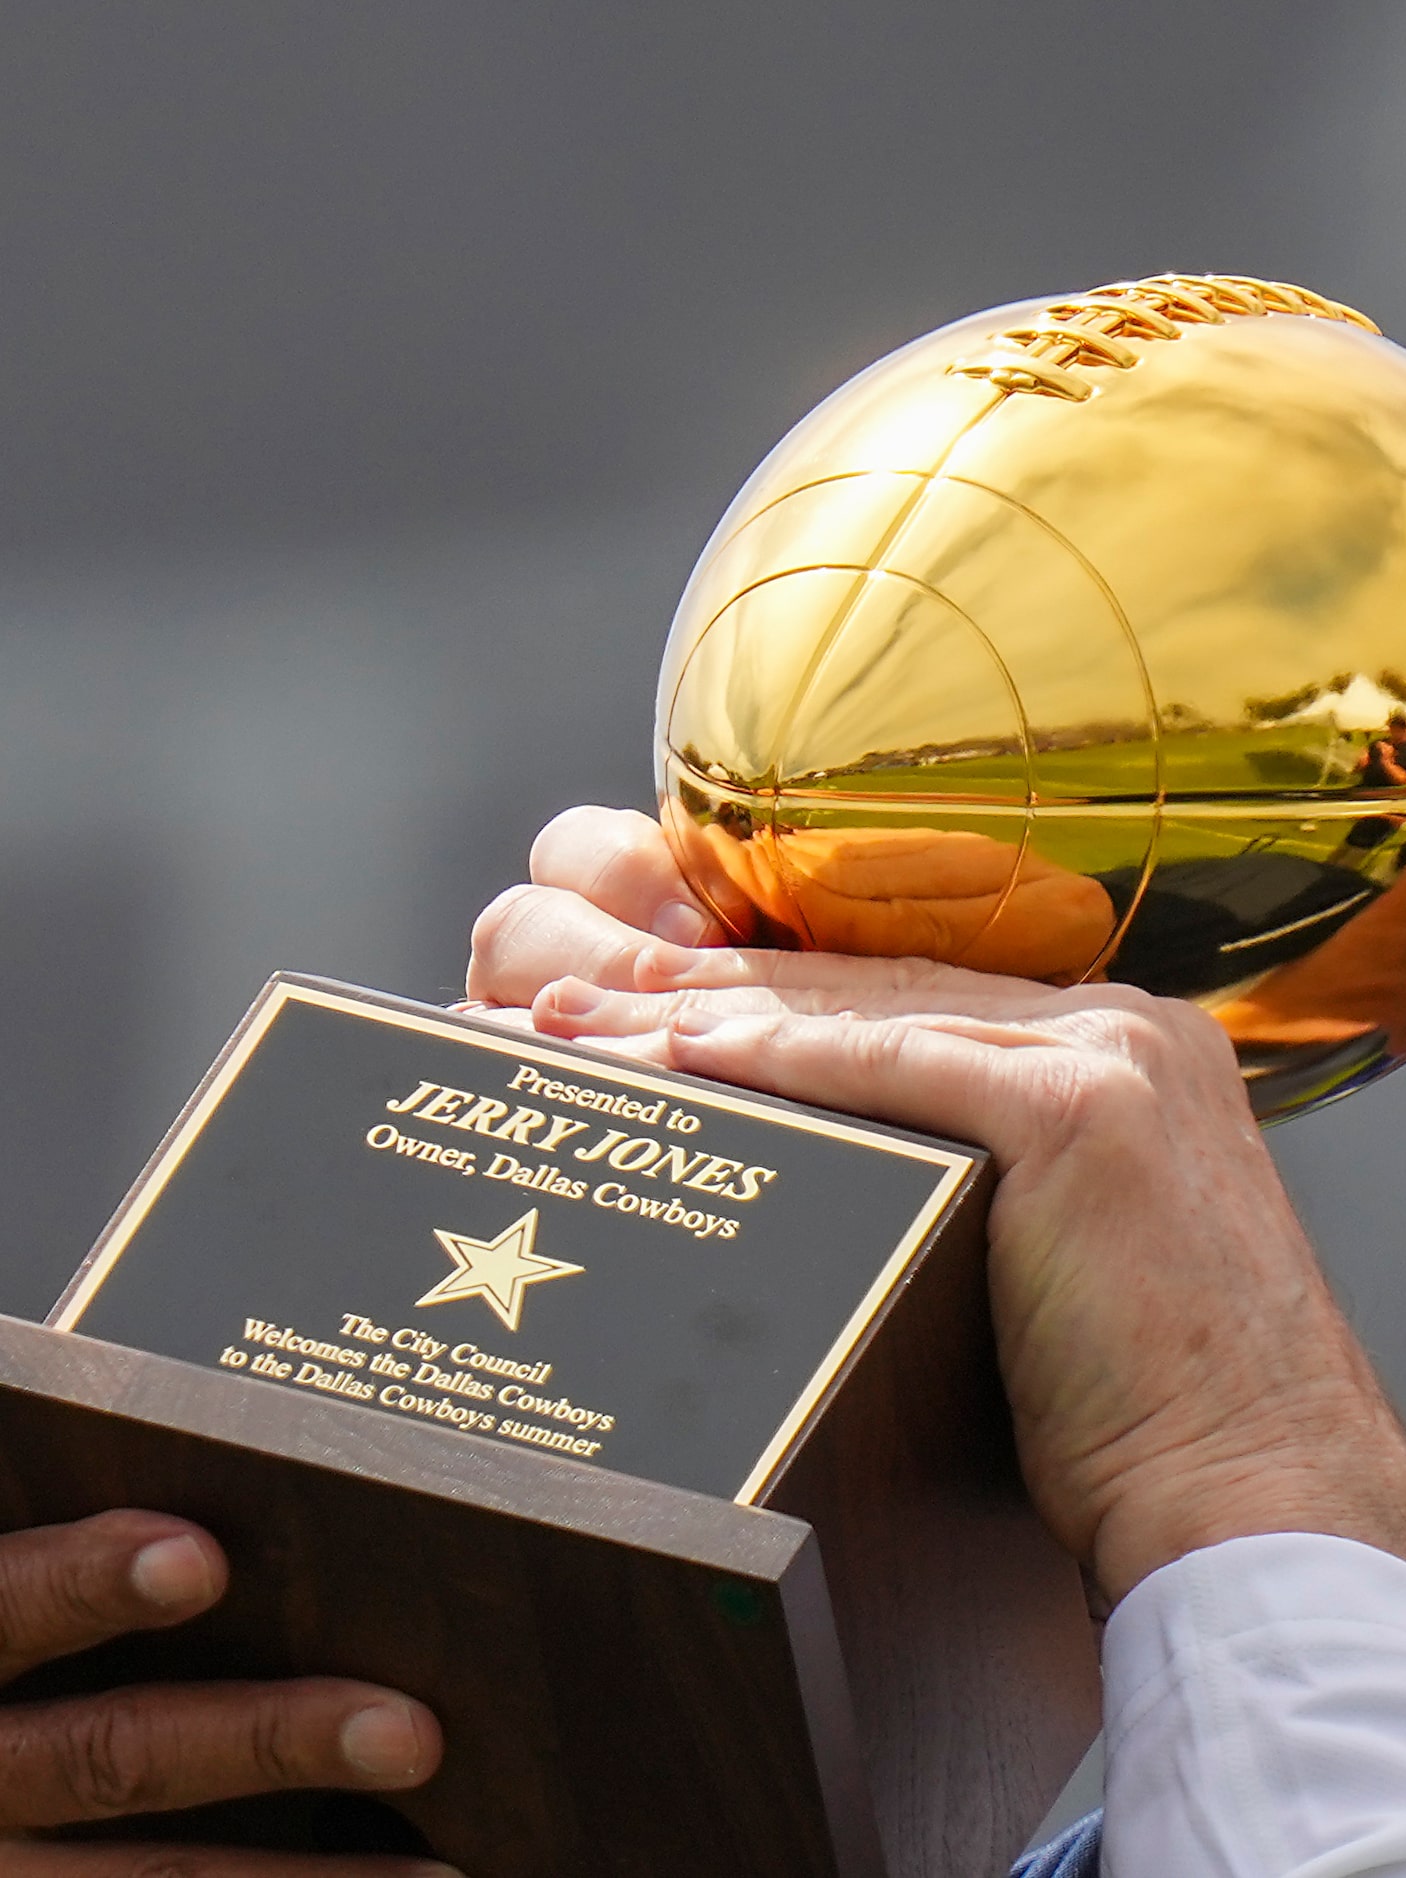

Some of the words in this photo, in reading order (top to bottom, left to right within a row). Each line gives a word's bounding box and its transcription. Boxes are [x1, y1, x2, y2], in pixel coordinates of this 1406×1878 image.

[386, 1080, 589, 1152] JERRY
[574, 1128, 779, 1201] JONES
[506, 1064, 668, 1125] Presented
[665, 1106, 701, 1134] to
[366, 1124, 478, 1177] Owner,
[483, 1152, 589, 1200] Dallas
[592, 1181, 740, 1239] Cowboys
[219, 1345, 247, 1369] to
[251, 1349, 293, 1379] the
[293, 1362, 376, 1401] Dallas
[379, 1384, 496, 1432] Cowboys
[498, 1417, 602, 1458] summer
[243, 1318, 367, 1368] Welcomes
[369, 1349, 411, 1379] the
[412, 1361, 496, 1400] Dallas
[498, 1384, 616, 1432] Cowboys
[338, 1312, 390, 1343] The
[392, 1326, 448, 1360] City
[451, 1342, 552, 1385] Council
